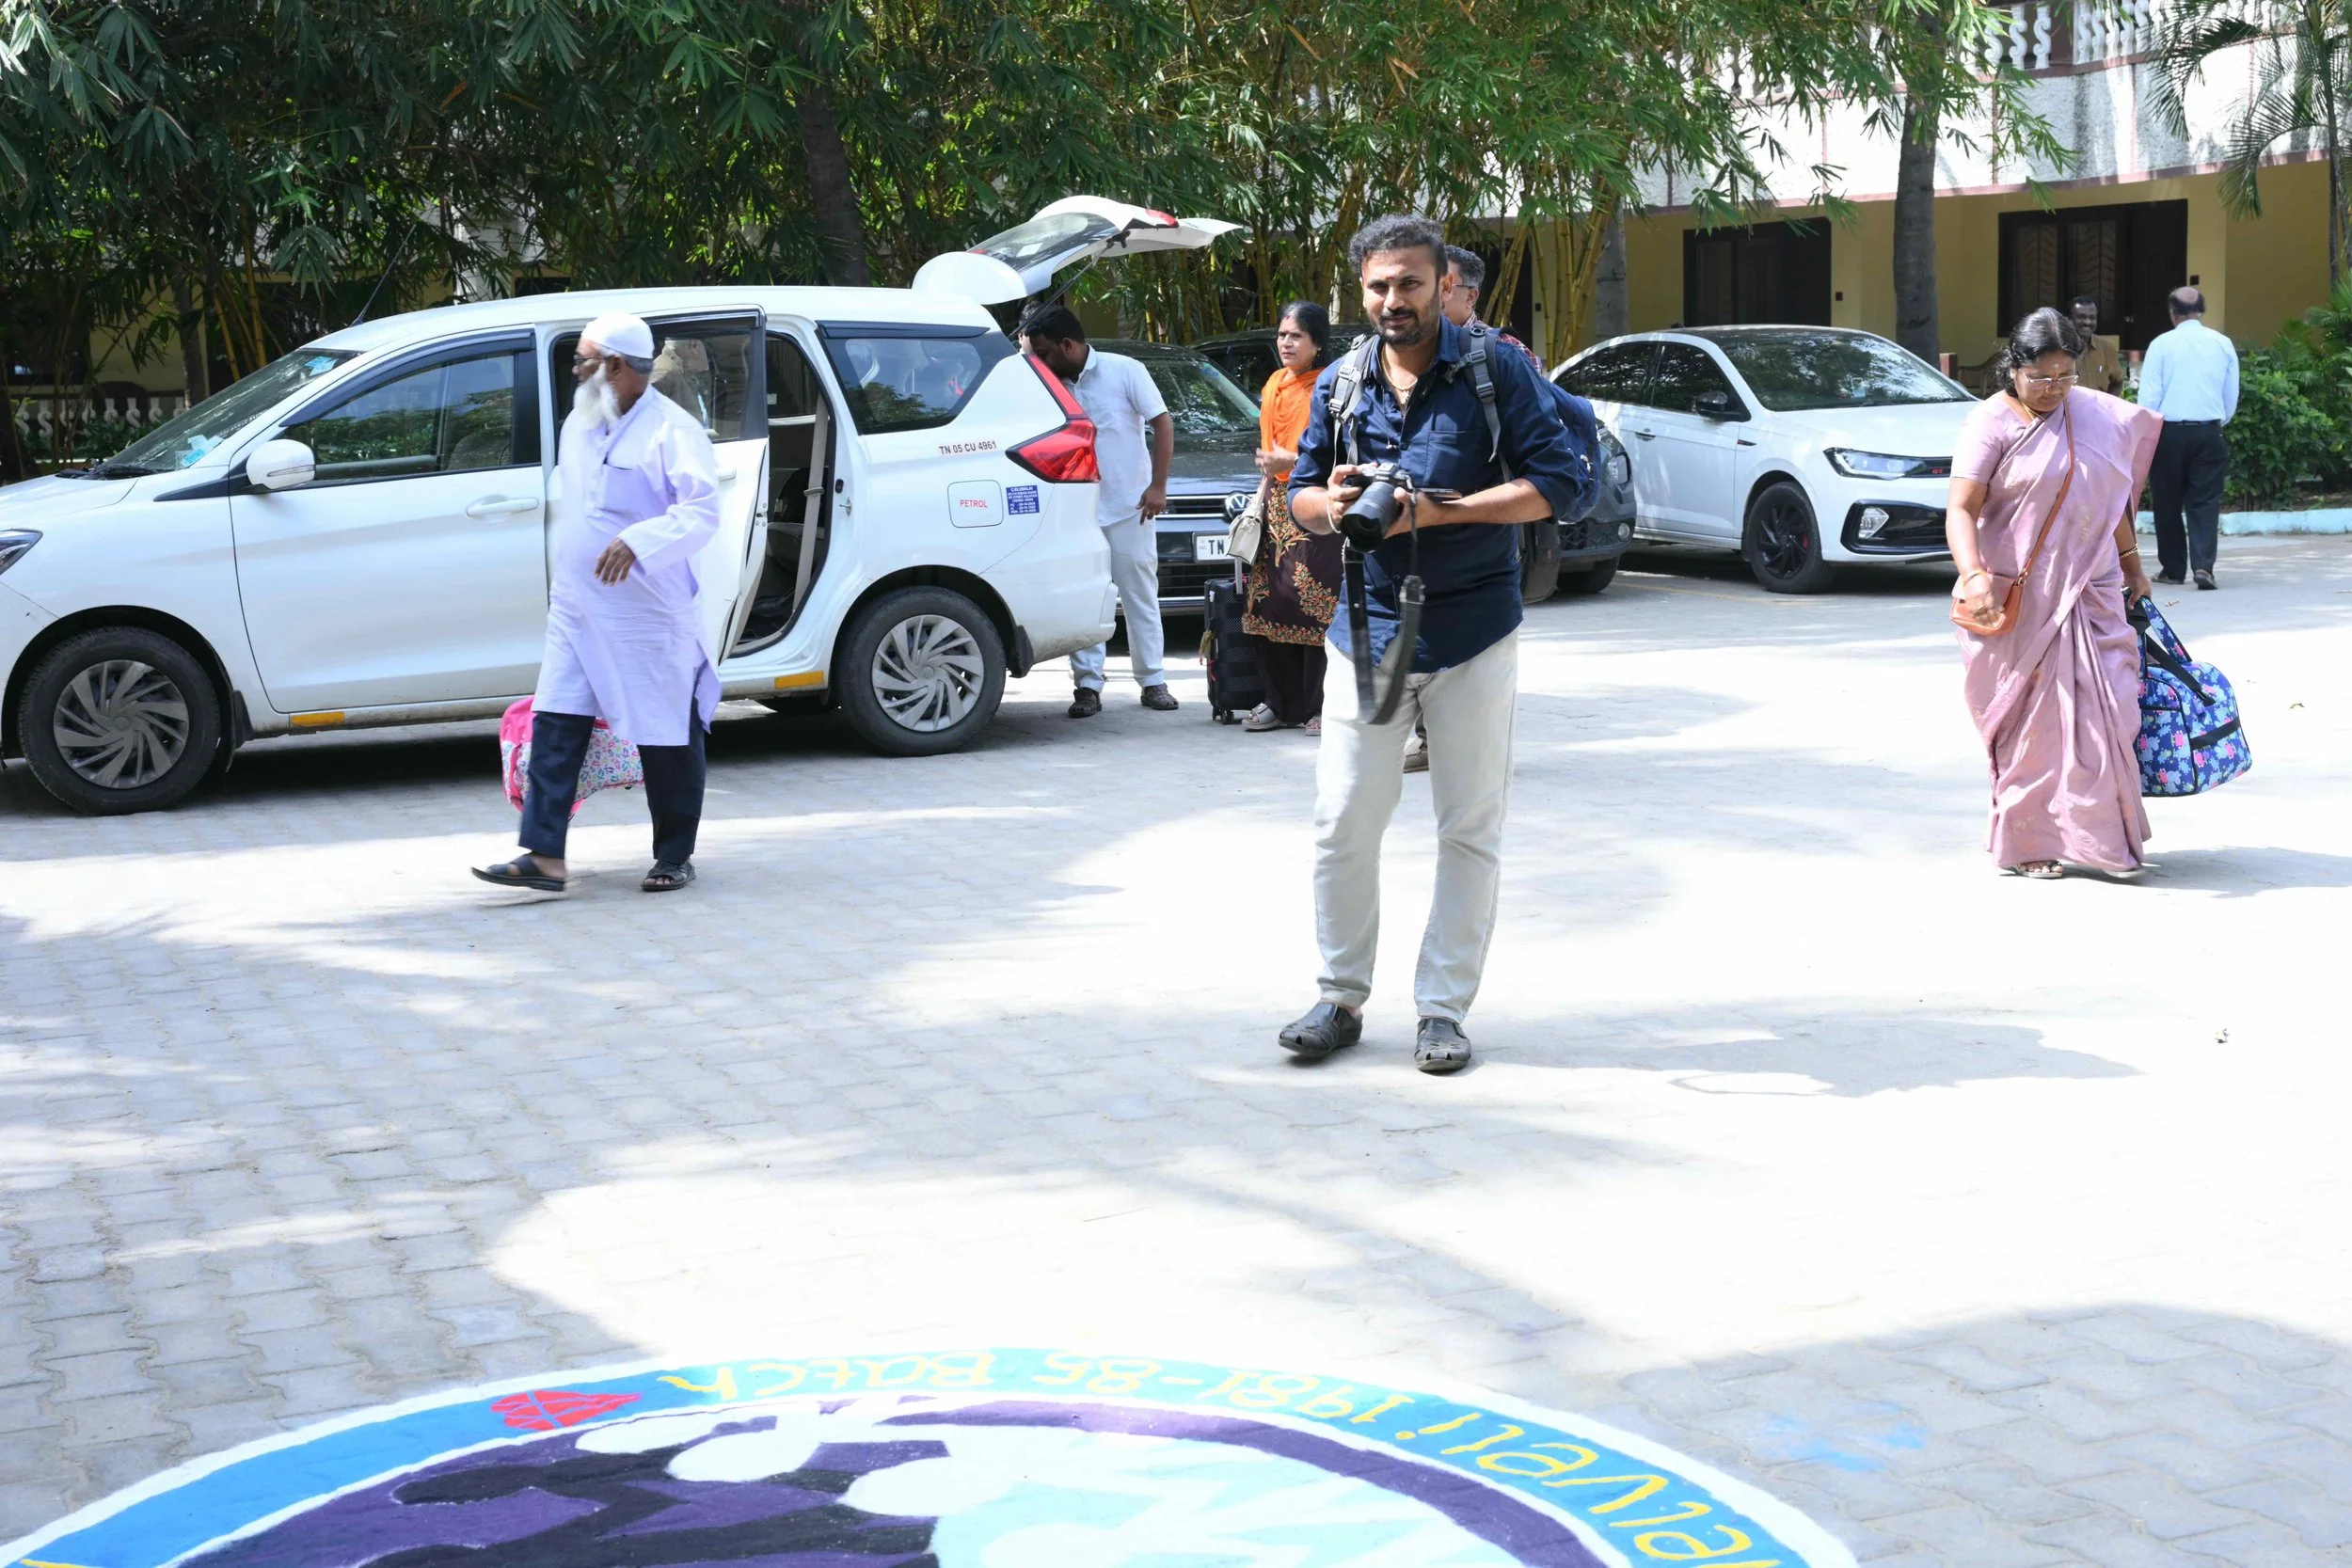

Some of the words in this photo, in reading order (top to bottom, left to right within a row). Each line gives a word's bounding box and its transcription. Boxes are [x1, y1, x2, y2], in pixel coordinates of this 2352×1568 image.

[939, 446, 951, 454] TN
[953, 444, 963, 453] 05
[964, 442, 976, 451] CU
[978, 440, 996, 451] 4961
[960, 499, 988, 508] PETROL
[1208, 539, 1225, 555] TN
